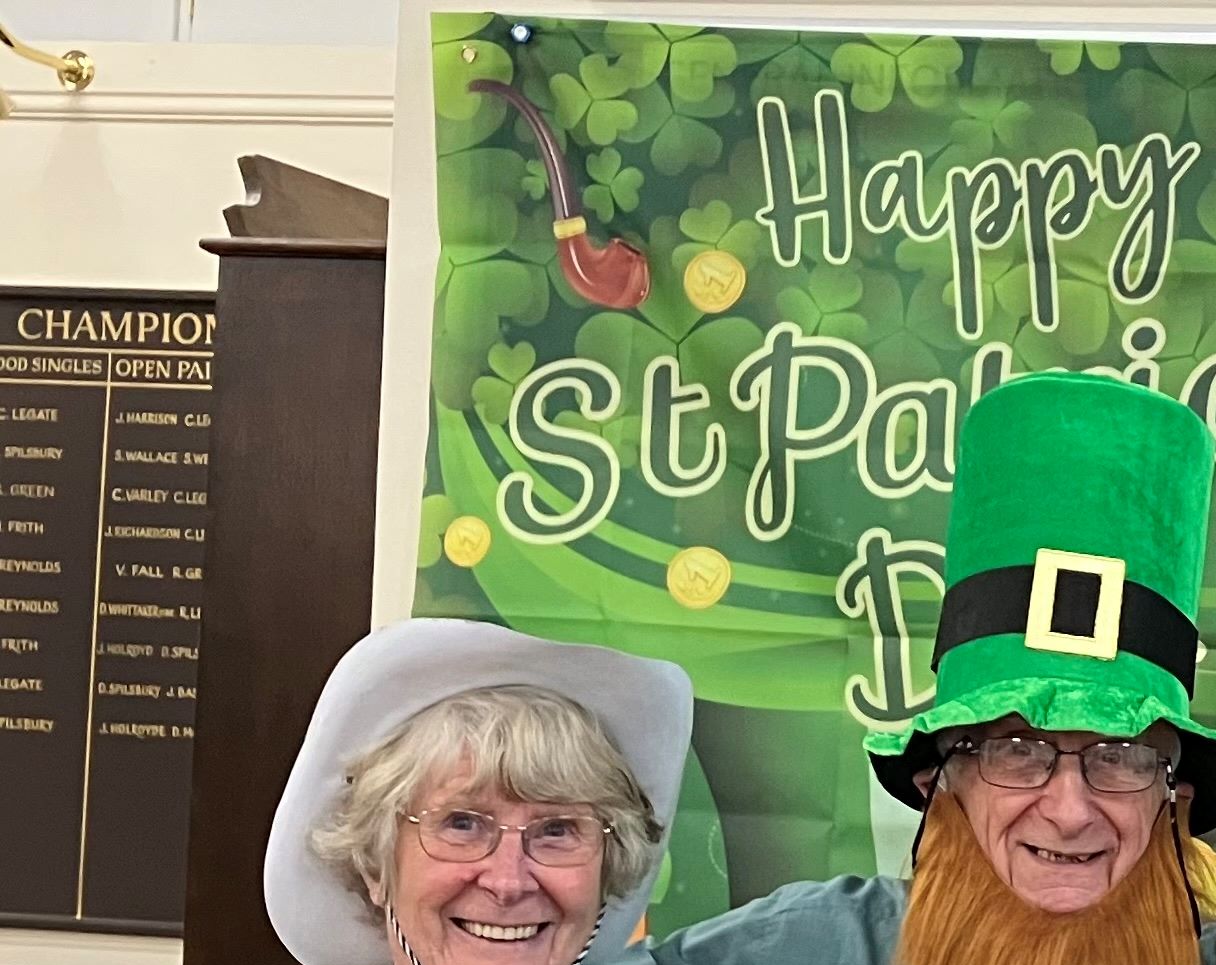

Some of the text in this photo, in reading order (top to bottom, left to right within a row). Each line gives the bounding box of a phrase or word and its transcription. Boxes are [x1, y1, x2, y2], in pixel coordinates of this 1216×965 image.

[755, 88, 1200, 339] Happy
[31, 357, 102, 375] SINGLES
[115, 358, 171, 379] OPEN
[12, 408, 59, 422] LEGATE
[10, 484, 55, 498] GREEN
[8, 520, 44, 535] FRITH
[1, 638, 39, 654] FRITH
